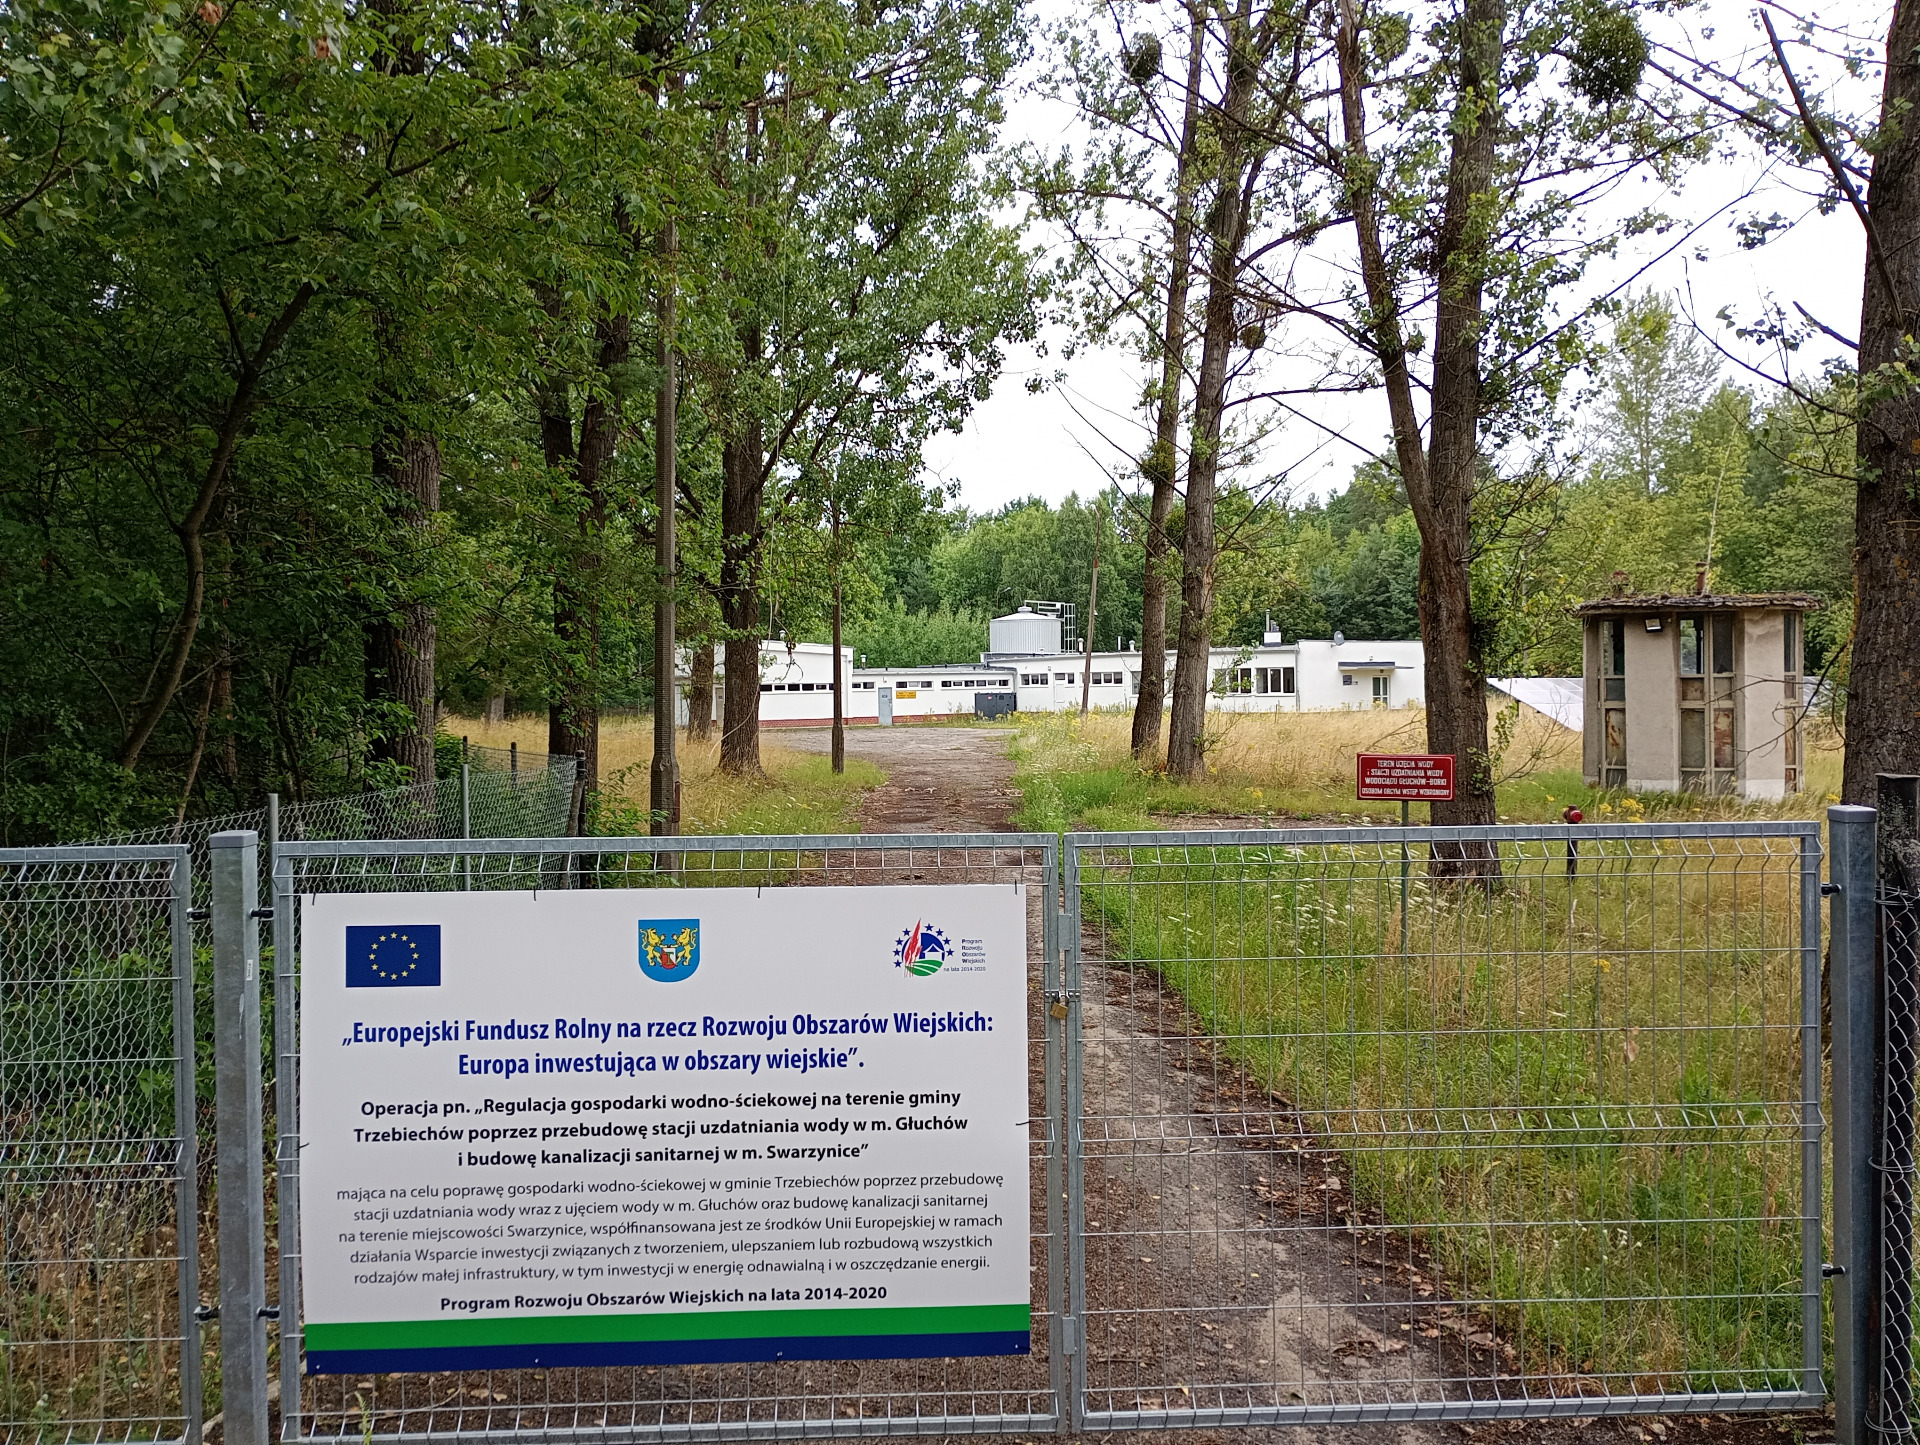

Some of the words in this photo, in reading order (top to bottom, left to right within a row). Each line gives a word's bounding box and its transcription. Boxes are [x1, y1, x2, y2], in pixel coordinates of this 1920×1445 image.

[1370, 768, 1390, 776] STACJI
[1426, 769, 1444, 778] WODY
[1377, 760, 1395, 768] TEREN
[1395, 760, 1416, 768] UJĘCIA
[1417, 760, 1434, 768] WODY
[465, 1018, 550, 1041] Fundusz
[554, 1017, 612, 1045] Rolny
[616, 1022, 642, 1039] na
[647, 1021, 698, 1038] rzecz
[702, 1014, 787, 1042] Rozwoju
[792, 1012, 889, 1036] Obszarów
[892, 1010, 993, 1039] Wiejskich:
[458, 1053, 530, 1080] Europa
[535, 1050, 657, 1078] inwestująca
[661, 1055, 680, 1072] w
[684, 1049, 762, 1076] obszary
[360, 1099, 439, 1120] Operacja
[442, 1102, 471, 1118] pn.
[570, 1094, 667, 1115] gospodarki
[670, 1091, 817, 1111] wodno-ściekowej
[821, 1094, 842, 1107] na
[845, 1090, 905, 1106] terenie
[908, 1089, 962, 1109] gminy
[353, 1125, 465, 1143] Trzebiechów
[468, 1127, 538, 1144] poprzez
[541, 1121, 649, 1142] przebudowę
[651, 1119, 696, 1139] stacji
[700, 1118, 800, 1135] uzdatniania
[803, 1116, 850, 1136] wody
[852, 1120, 868, 1132] w
[871, 1120, 892, 1132] m.
[895, 1115, 969, 1131] Głuchów
[457, 1151, 463, 1167] i
[467, 1150, 537, 1169] budowę
[541, 1147, 631, 1167] kanalizacji
[634, 1145, 720, 1165] sanitarnej
[723, 1149, 738, 1160] w
[741, 1148, 763, 1160] m.
[336, 1187, 386, 1203] mająca
[390, 1188, 407, 1199] na
[410, 1184, 439, 1198] celu
[442, 1185, 505, 1201] poprawę
[507, 1180, 584, 1199] gospodarki
[587, 1177, 706, 1194] wodno-ściekowej
[709, 1180, 722, 1190] w
[724, 1176, 772, 1193] gminie
[773, 1174, 861, 1189] Trzebiechów
[863, 1176, 918, 1191] poprzez
[920, 1172, 1004, 1190] przebudowę
[353, 1207, 389, 1224] stacji
[393, 1205, 474, 1220] uzdatniania
[476, 1203, 516, 1220] wody
[518, 1205, 552, 1216] wraz
[553, 1205, 562, 1215] z
[565, 1201, 619, 1218] ujęciem
[621, 1199, 660, 1216] wody
[662, 1202, 675, 1212] w
[678, 1202, 696, 1212] m.
[698, 1197, 759, 1212] Głuchów
[761, 1199, 791, 1210] oraz
[793, 1195, 849, 1212] budowę
[852, 1194, 920, 1211] kanalizacji
[923, 1193, 988, 1209] sanitarnej
[338, 1232, 356, 1243] na
[358, 1228, 409, 1242] terenie
[412, 1225, 504, 1243] miejscowości
[507, 1223, 587, 1240] Swarzynice,
[589, 1220, 716, 1238] współfinansowana
[717, 1219, 744, 1235] jest
[745, 1221, 762, 1232] ze
[764, 1216, 823, 1231] środków
[825, 1216, 852, 1230] Unii
[855, 1214, 935, 1232] Europejskiej
[938, 1217, 951, 1228] w
[953, 1213, 1003, 1228] ramach
[349, 1249, 412, 1264] działania
[414, 1247, 478, 1264] Wsparcie
[481, 1244, 549, 1261] inwestycji
[551, 1242, 631, 1260] związanych
[633, 1245, 642, 1255] z
[643, 1240, 728, 1255] tworzeniem,
[731, 1238, 816, 1255] ulepszaniem
[819, 1237, 841, 1251] lub
[844, 1236, 920, 1252] rozbudową
[922, 1234, 993, 1252] wszystkich
[354, 1269, 419, 1286] rodzajów
[421, 1268, 460, 1285] małej
[463, 1265, 559, 1282] infrastruktury,
[561, 1267, 575, 1278] w
[577, 1265, 604, 1281] tym
[607, 1262, 674, 1279] inwestycji
[677, 1264, 690, 1275] w
[692, 1260, 744, 1277] energię
[747, 1258, 826, 1275] odnawialną
[828, 1258, 832, 1271] i
[834, 1261, 848, 1271] w
[850, 1256, 938, 1273] oszczędzanie
[940, 1255, 990, 1272] energii.
[440, 1297, 511, 1314] Program
[514, 1292, 583, 1311] Rozwoju
[586, 1290, 666, 1307] Obszarów
[668, 1288, 744, 1307] Wiejskich
[748, 1291, 767, 1302] na
[771, 1287, 801, 1302] lata
[804, 1286, 888, 1301] 2014-2020
